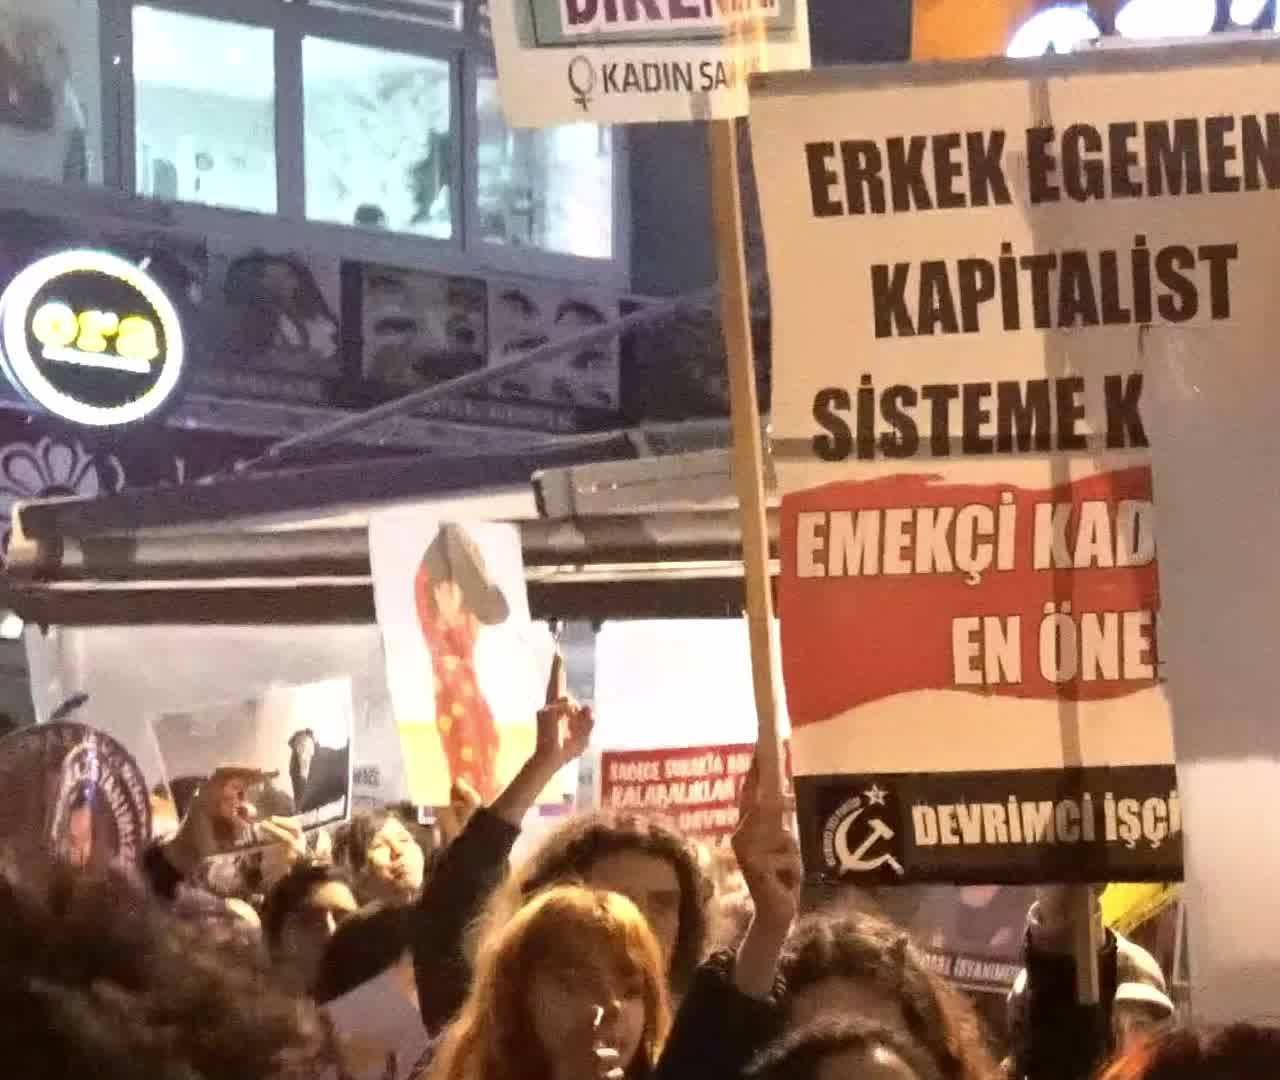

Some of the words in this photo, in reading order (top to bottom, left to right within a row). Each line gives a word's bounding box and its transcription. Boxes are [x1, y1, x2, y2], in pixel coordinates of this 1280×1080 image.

[602, 61, 693, 93] KADIN
[805, 130, 1015, 217] ERKEK
[870, 235, 1238, 339] KAPİTALİST
[811, 374, 1090, 462] SİSTEME
[796, 491, 1016, 585] EMEKÇİ
[1033, 499, 1156, 570] KAD
[951, 613, 1023, 685] EN
[1038, 600, 1155, 683] ÖNE
[911, 792, 1096, 847] DEVRİMCİ
[1103, 790, 1183, 849] İŞÇİ
